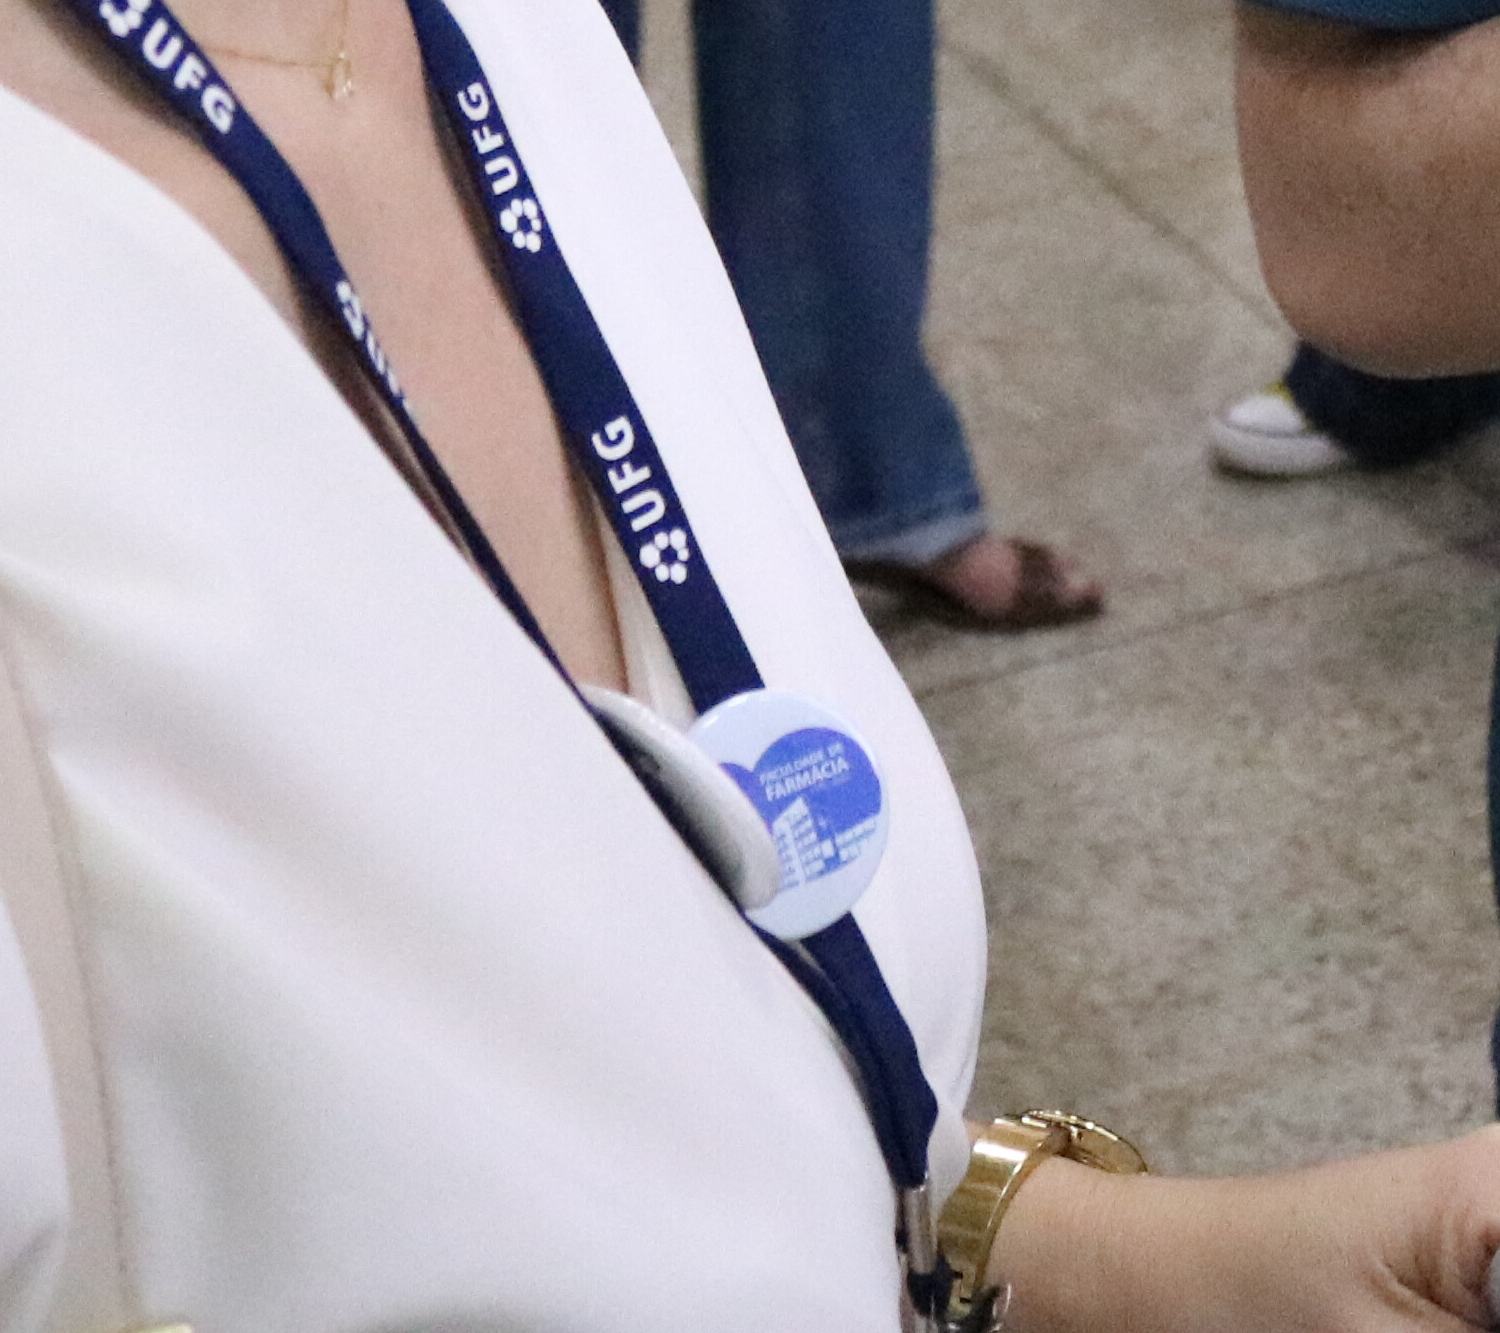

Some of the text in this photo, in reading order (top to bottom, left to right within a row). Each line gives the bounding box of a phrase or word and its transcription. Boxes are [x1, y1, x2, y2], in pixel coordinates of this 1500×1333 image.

[142, 17, 235, 134] UFG
[457, 81, 519, 196] UFG
[592, 416, 668, 533] UFG
[765, 757, 850, 802] FARMÁCIA
